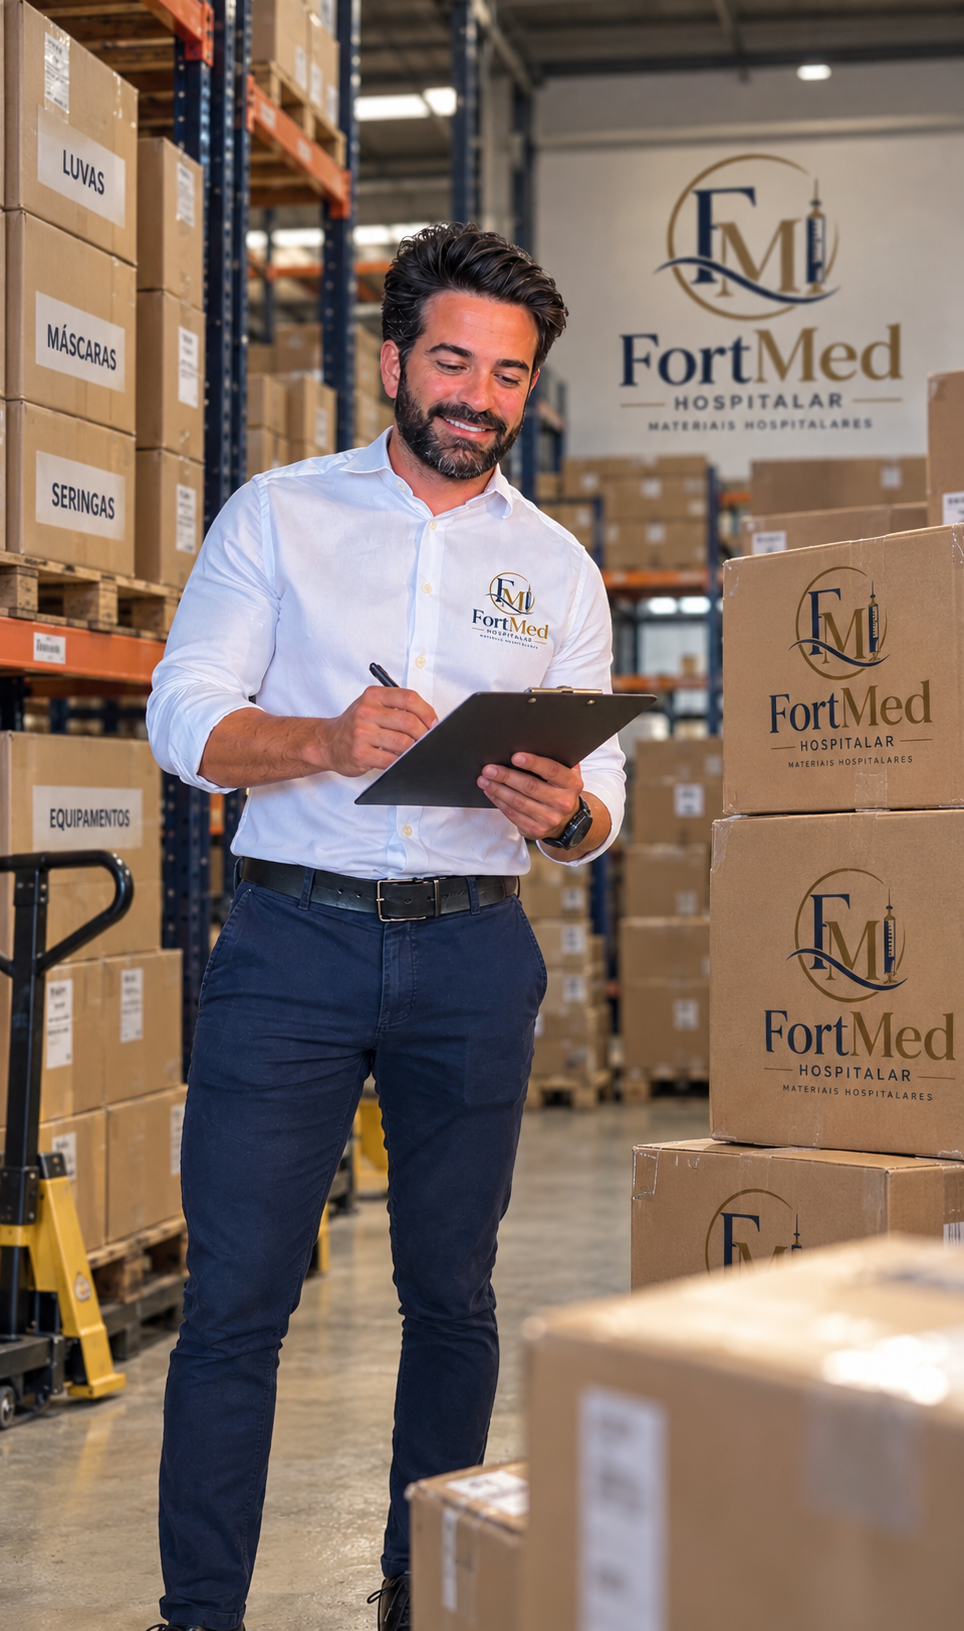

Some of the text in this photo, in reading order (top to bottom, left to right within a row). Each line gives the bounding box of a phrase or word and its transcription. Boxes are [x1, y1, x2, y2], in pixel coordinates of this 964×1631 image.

[63, 149, 105, 195] LUVAS
[47, 323, 117, 371] MÁSCARAS
[618, 323, 904, 388] FortMed
[674, 393, 844, 412] HOSPITALAR
[648, 418, 873, 433] MATERIAIS HOSPITALARES
[51, 482, 115, 520] SERINGAS
[472, 609, 549, 640] FortMed
[769, 679, 933, 734] FortMed
[799, 735, 895, 752] HOSPITALAR
[788, 755, 914, 769] MATERIAIS HOSPITALARES
[49, 808, 131, 832] EQUIPAMENTOS
[763, 1009, 957, 1061] FortMed
[799, 1064, 911, 1082] HOSPITALAR
[782, 1084, 934, 1102] MATERIAIS HOSPITALARES
